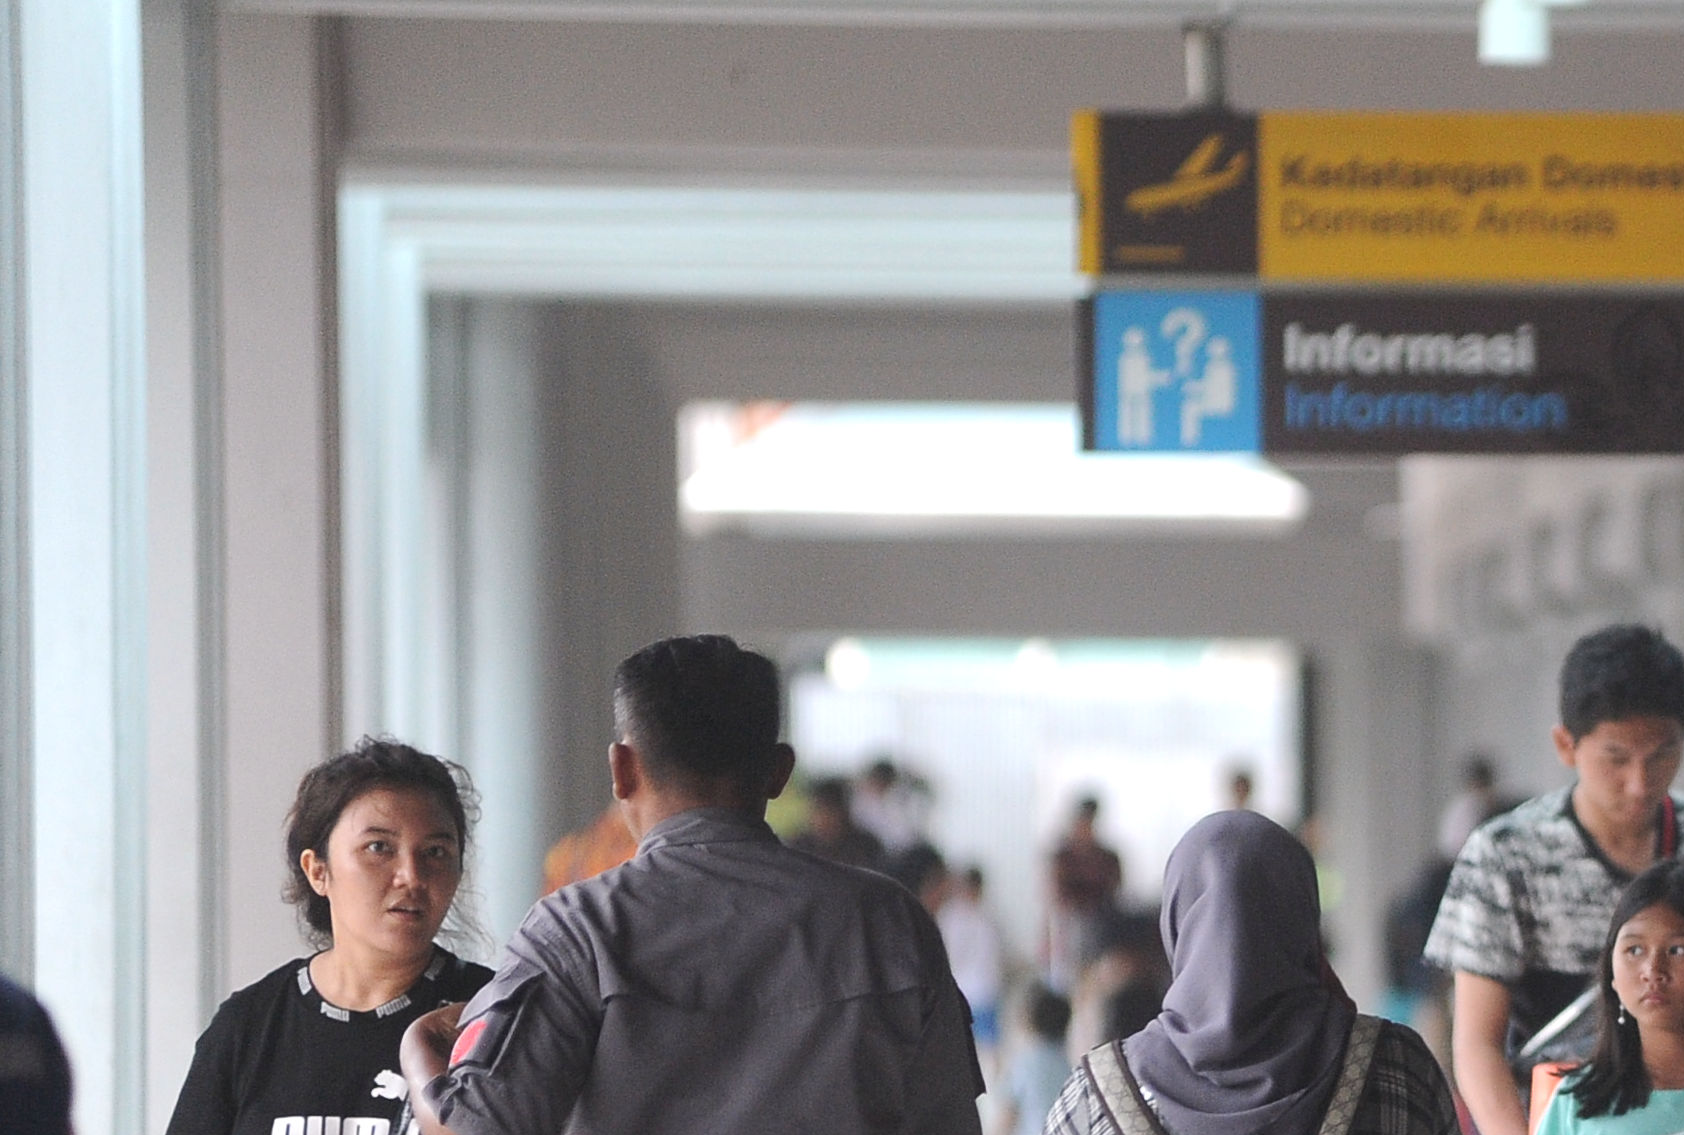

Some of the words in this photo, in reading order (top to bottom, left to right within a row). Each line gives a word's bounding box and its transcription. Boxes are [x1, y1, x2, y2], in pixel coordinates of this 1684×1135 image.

[1281, 202, 1463, 236] Domestic
[1475, 201, 1618, 236] Arrivals
[1283, 322, 1534, 374] Informasi
[1283, 382, 1567, 430] Information
